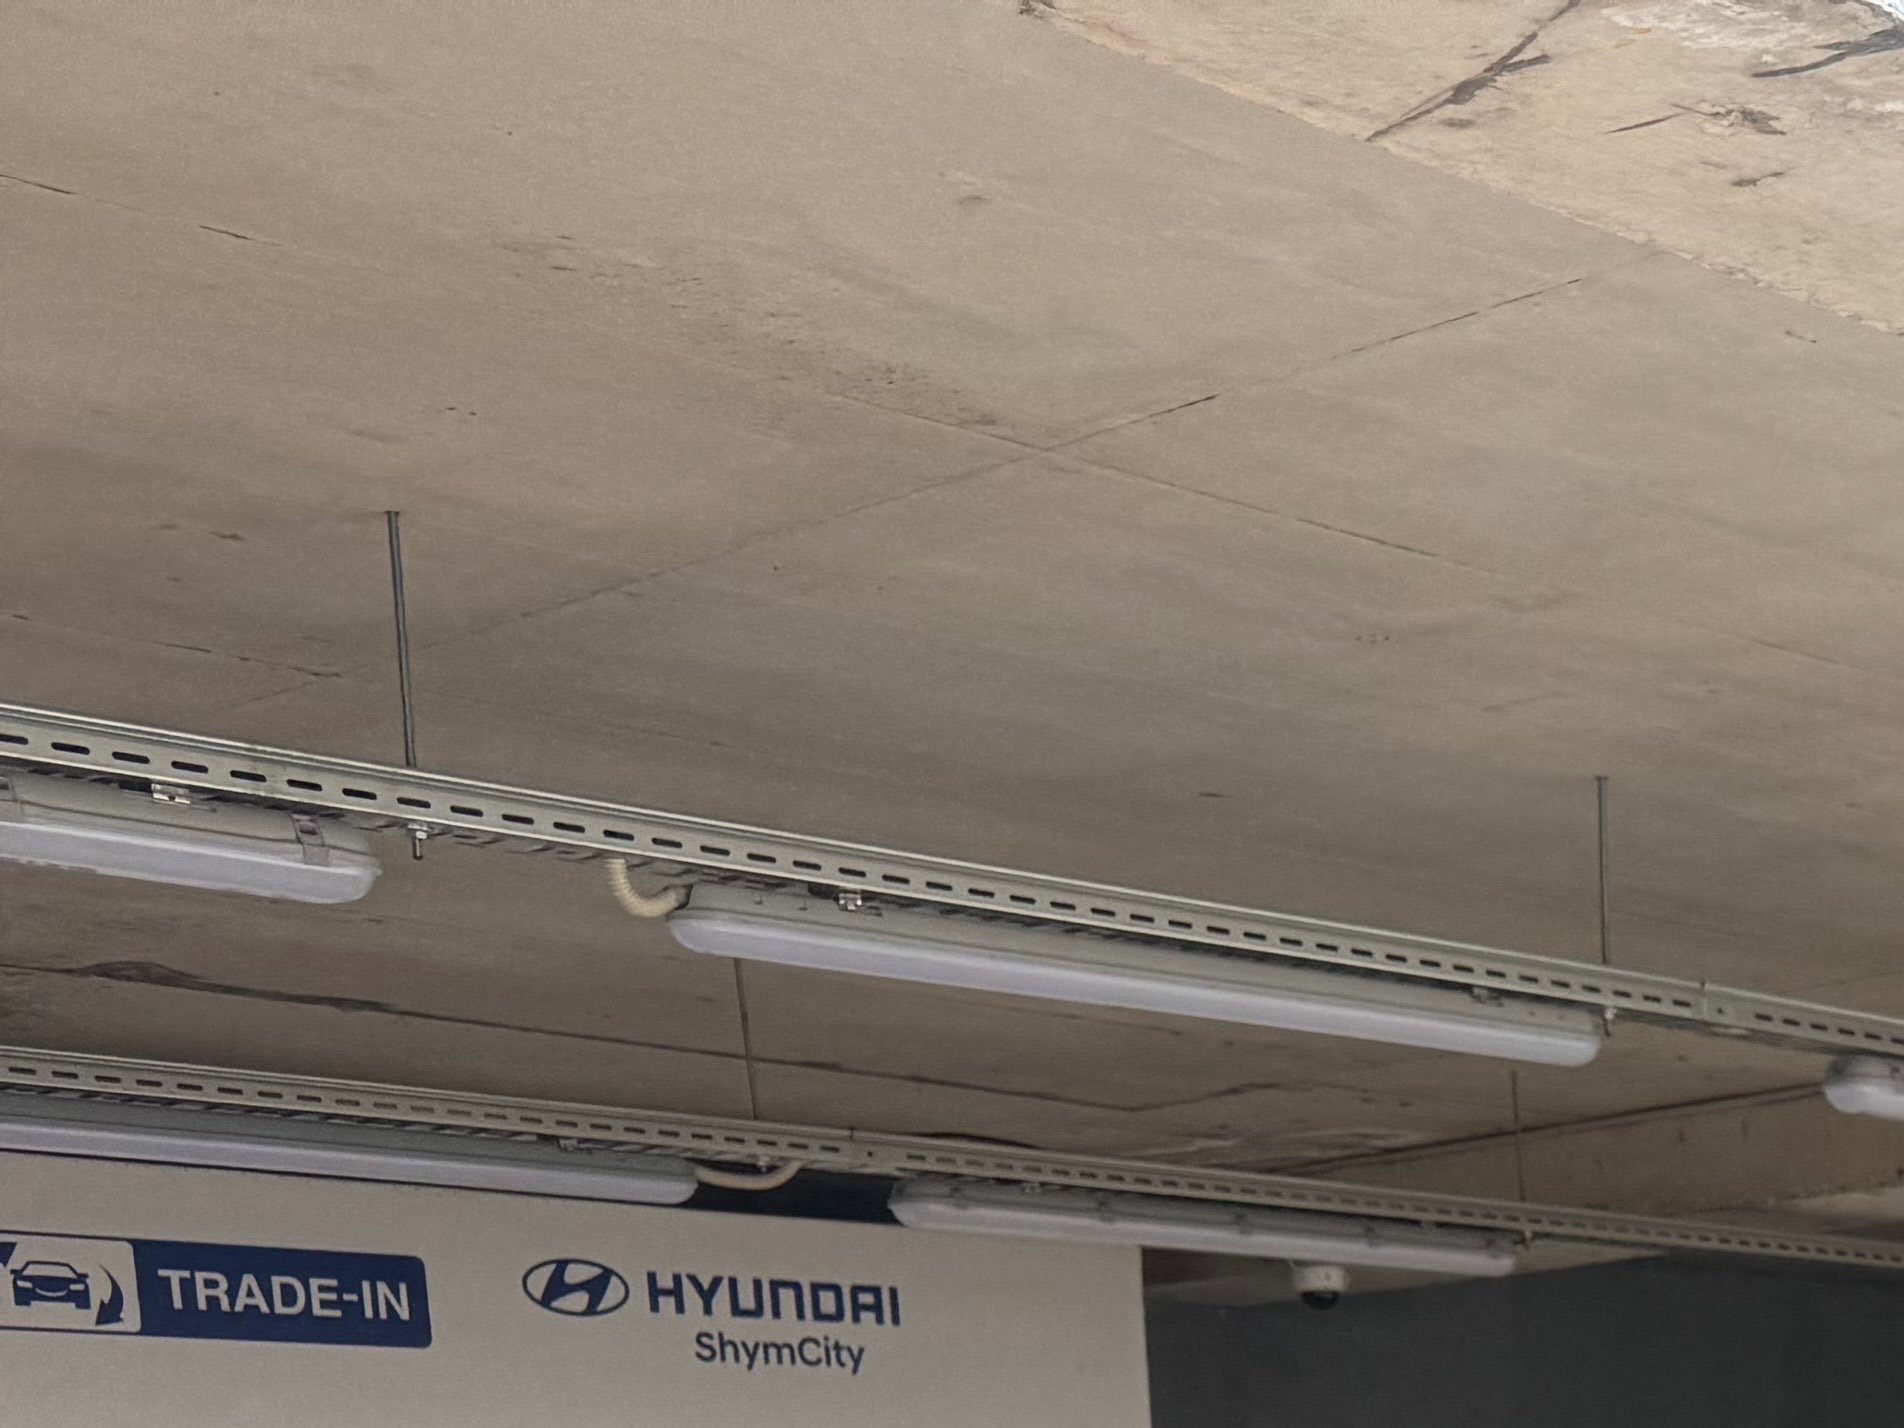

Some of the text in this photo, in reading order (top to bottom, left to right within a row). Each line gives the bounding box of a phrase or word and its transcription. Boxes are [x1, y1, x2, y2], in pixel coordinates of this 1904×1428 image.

[157, 1268, 410, 1321] TRADE-IN
[646, 1270, 901, 1327] HYUNDAI
[695, 1331, 865, 1375] ShymCity
